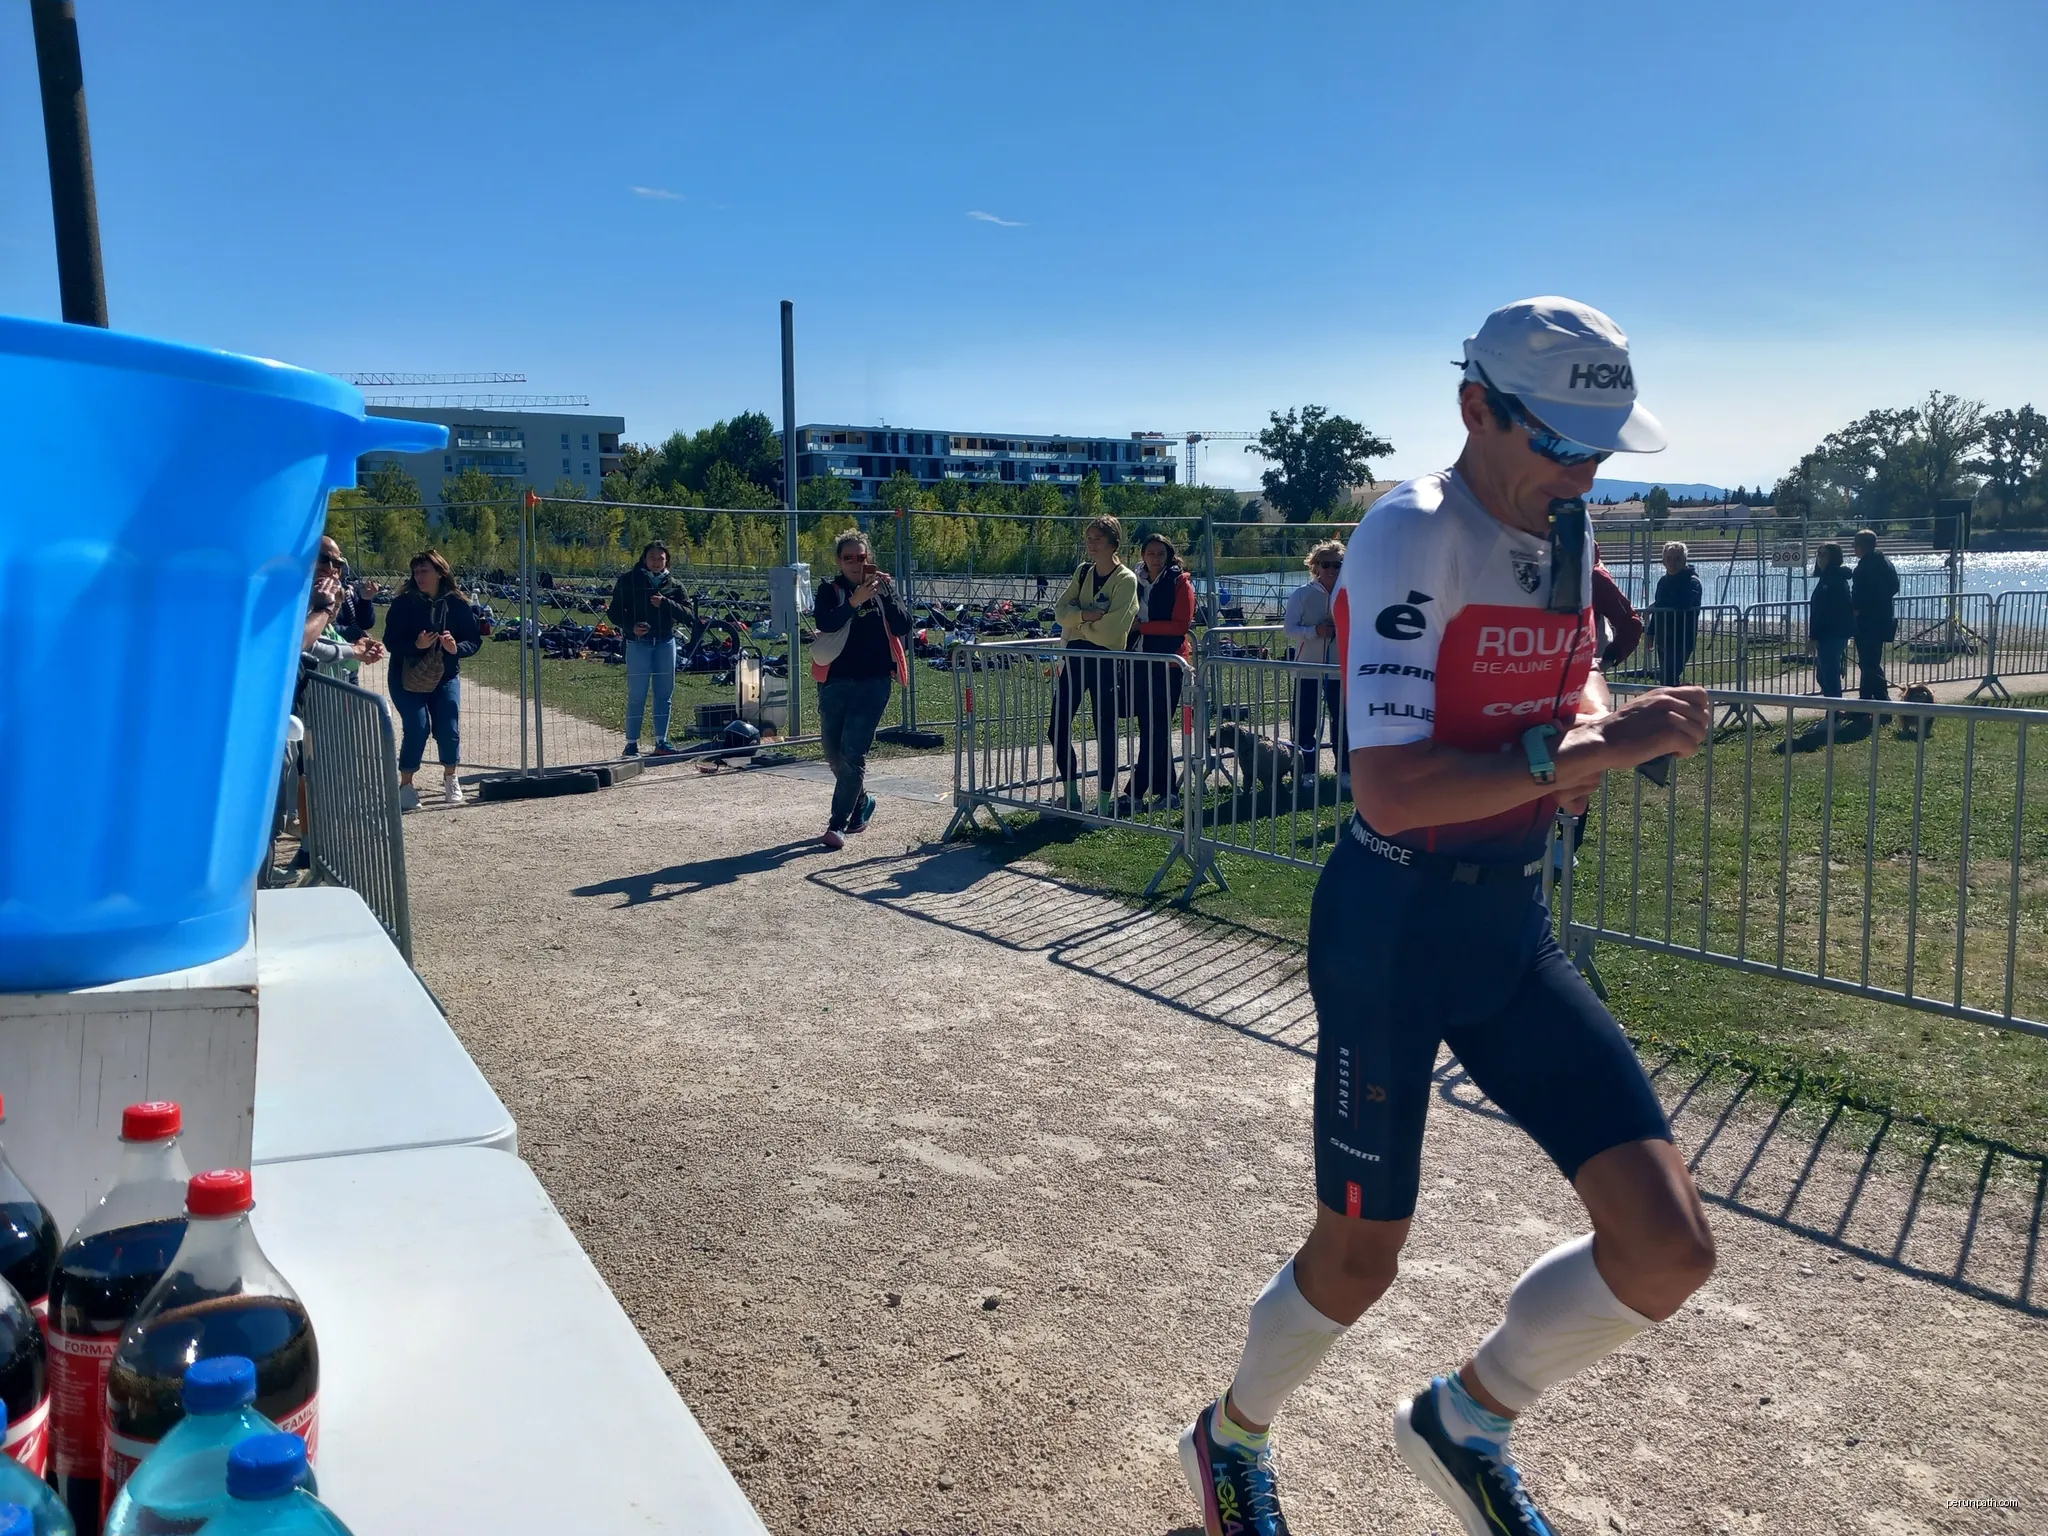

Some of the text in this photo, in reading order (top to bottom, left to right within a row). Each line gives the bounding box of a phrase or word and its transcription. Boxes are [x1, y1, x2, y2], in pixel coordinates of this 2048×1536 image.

[1569, 363, 1634, 389] HOKA
[1472, 660, 1553, 674] BEAUNE
[1338, 1047, 1350, 1119] RESERVE
[1329, 1136, 1381, 1163] SRAM
